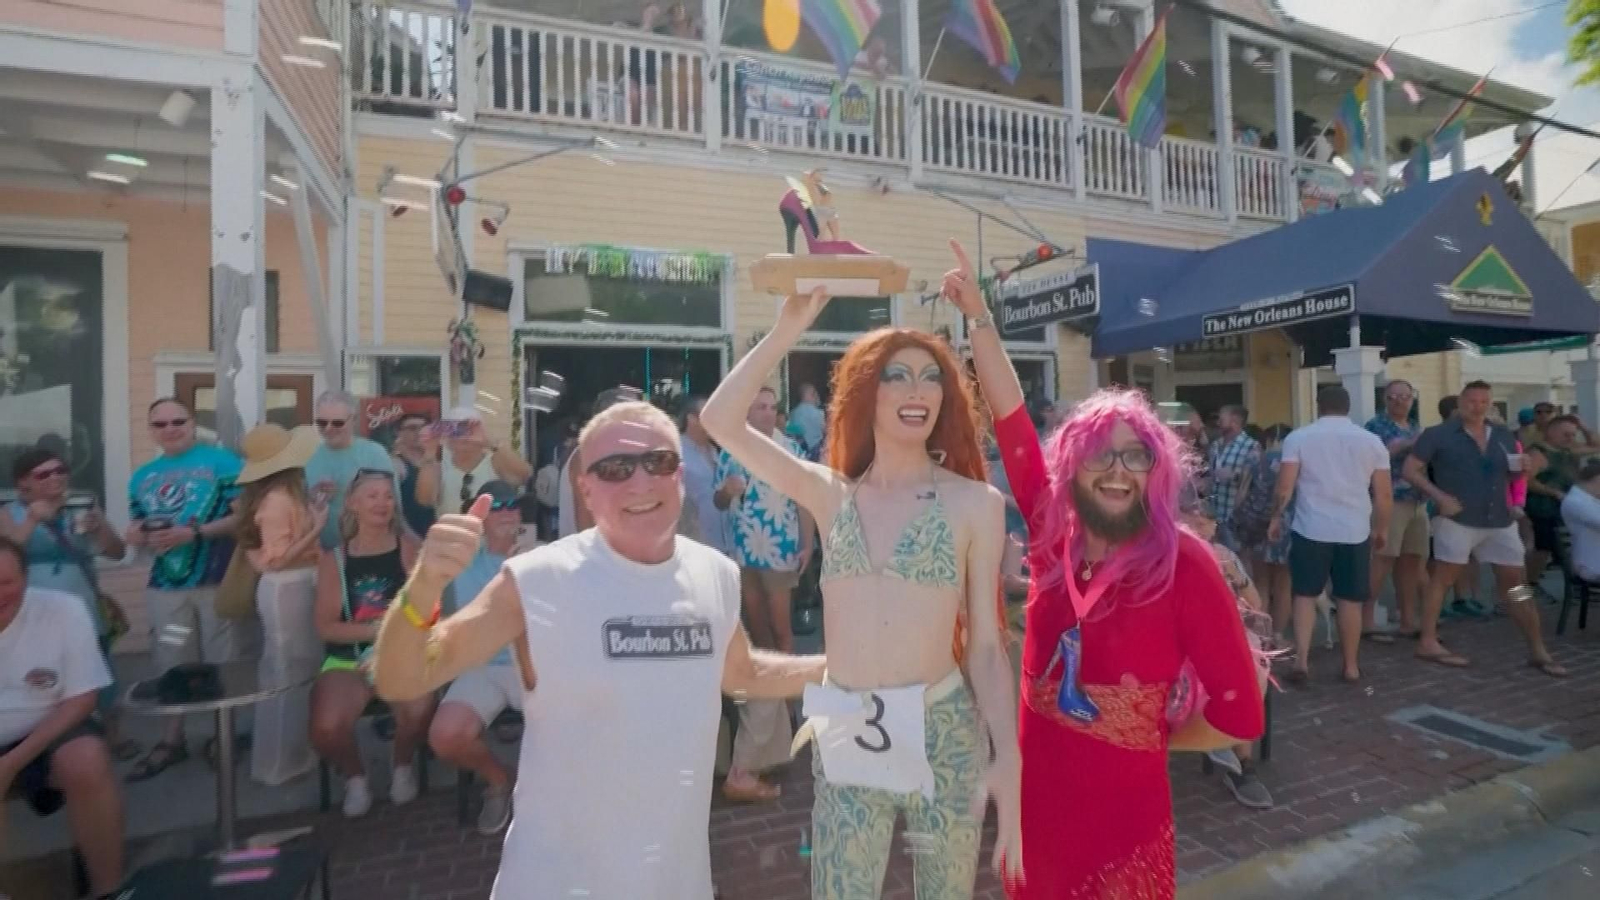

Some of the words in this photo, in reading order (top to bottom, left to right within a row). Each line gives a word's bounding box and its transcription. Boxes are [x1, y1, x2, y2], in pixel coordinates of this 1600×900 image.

[1004, 299, 1051, 325] Bourbon
[1052, 292, 1069, 313] St.
[1069, 284, 1095, 310] Pub
[1205, 319, 1226, 333] The
[1228, 314, 1252, 329] New
[1254, 304, 1302, 325] Orleans
[1305, 294, 1348, 314] House
[609, 628, 671, 654] Bourbon
[672, 628, 689, 652] St.
[690, 628, 711, 650] Pub
[854, 691, 891, 753] 3
